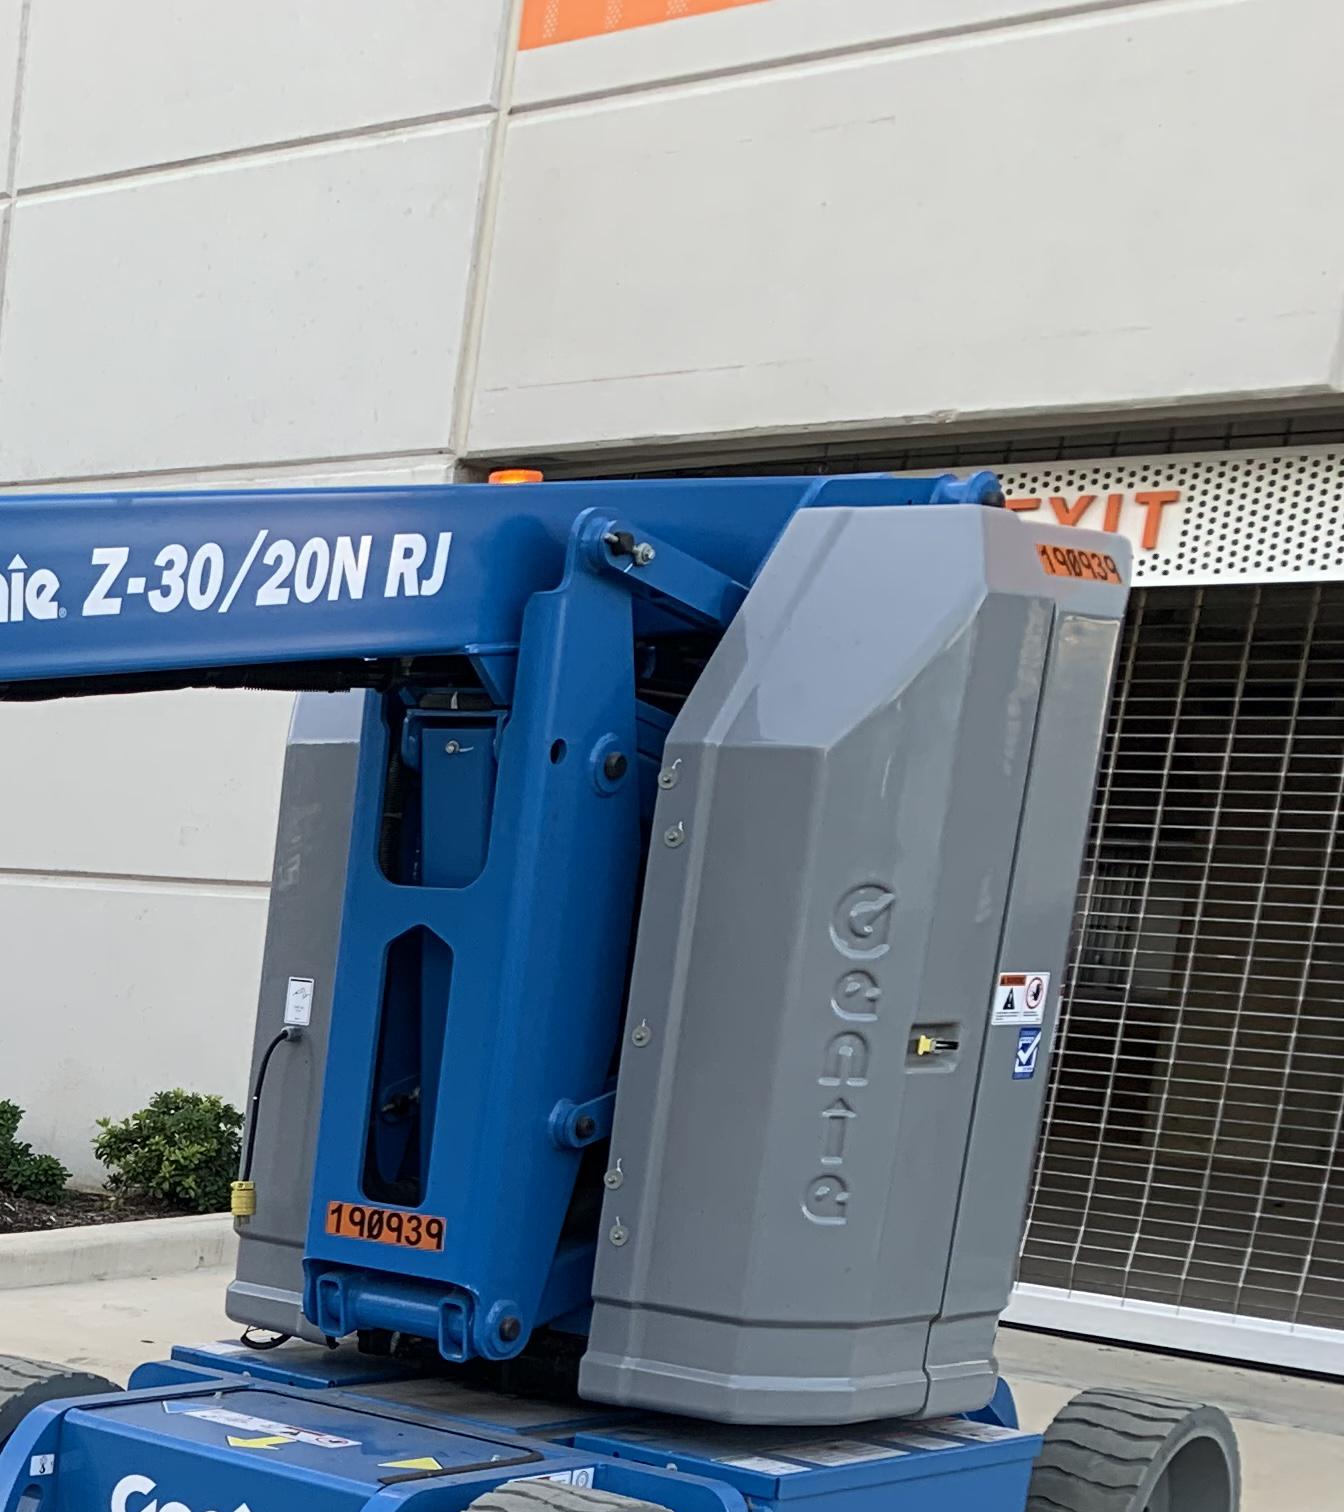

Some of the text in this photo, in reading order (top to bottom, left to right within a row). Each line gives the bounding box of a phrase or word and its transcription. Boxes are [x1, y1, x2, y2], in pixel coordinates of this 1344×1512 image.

[1005, 491, 1180, 550] XIT
[82, 529, 372, 617] Z-30/20N
[384, 531, 453, 598] RJ
[1039, 544, 1120, 584] 190939
[330, 1204, 444, 1250] 190939
